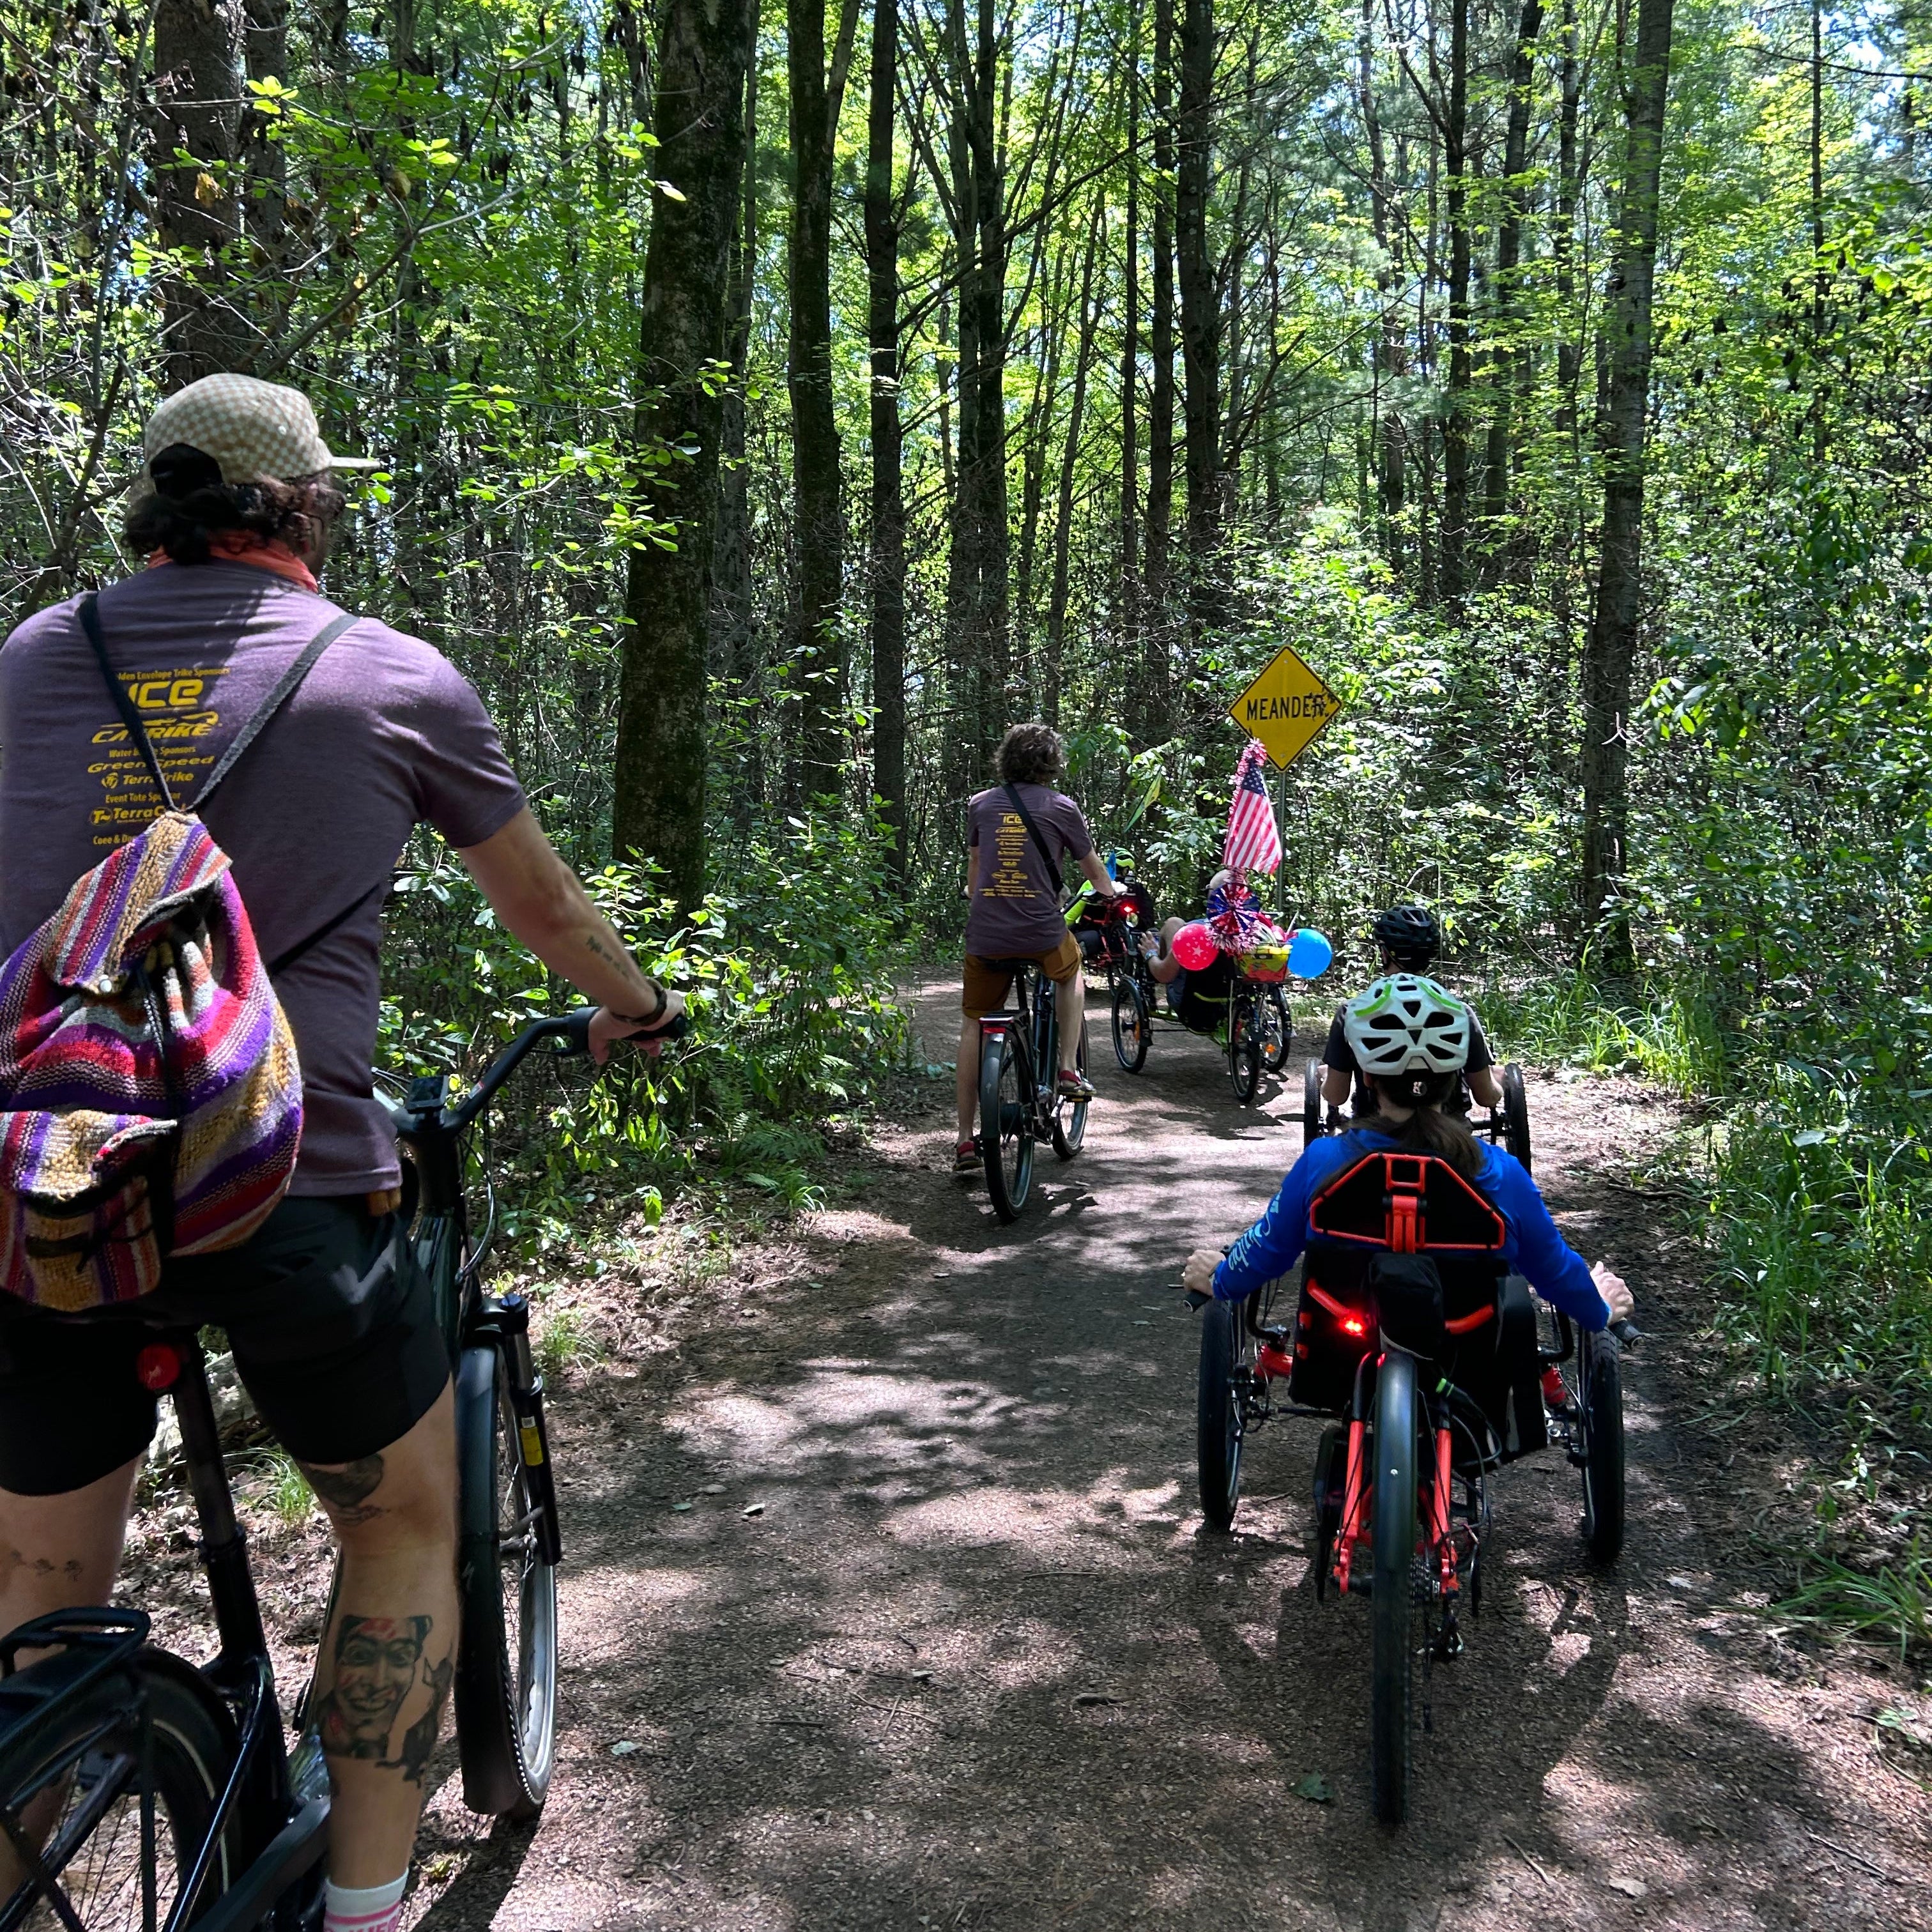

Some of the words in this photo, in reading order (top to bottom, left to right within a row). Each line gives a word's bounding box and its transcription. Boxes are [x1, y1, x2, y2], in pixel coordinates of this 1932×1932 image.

[174, 668, 192, 678] Trike
[1247, 694, 1324, 721] MEANDER
[91, 723, 212, 743] CARIKE
[109, 749, 132, 758] Water
[105, 794, 128, 803] Event
[129, 792, 147, 802] Tote
